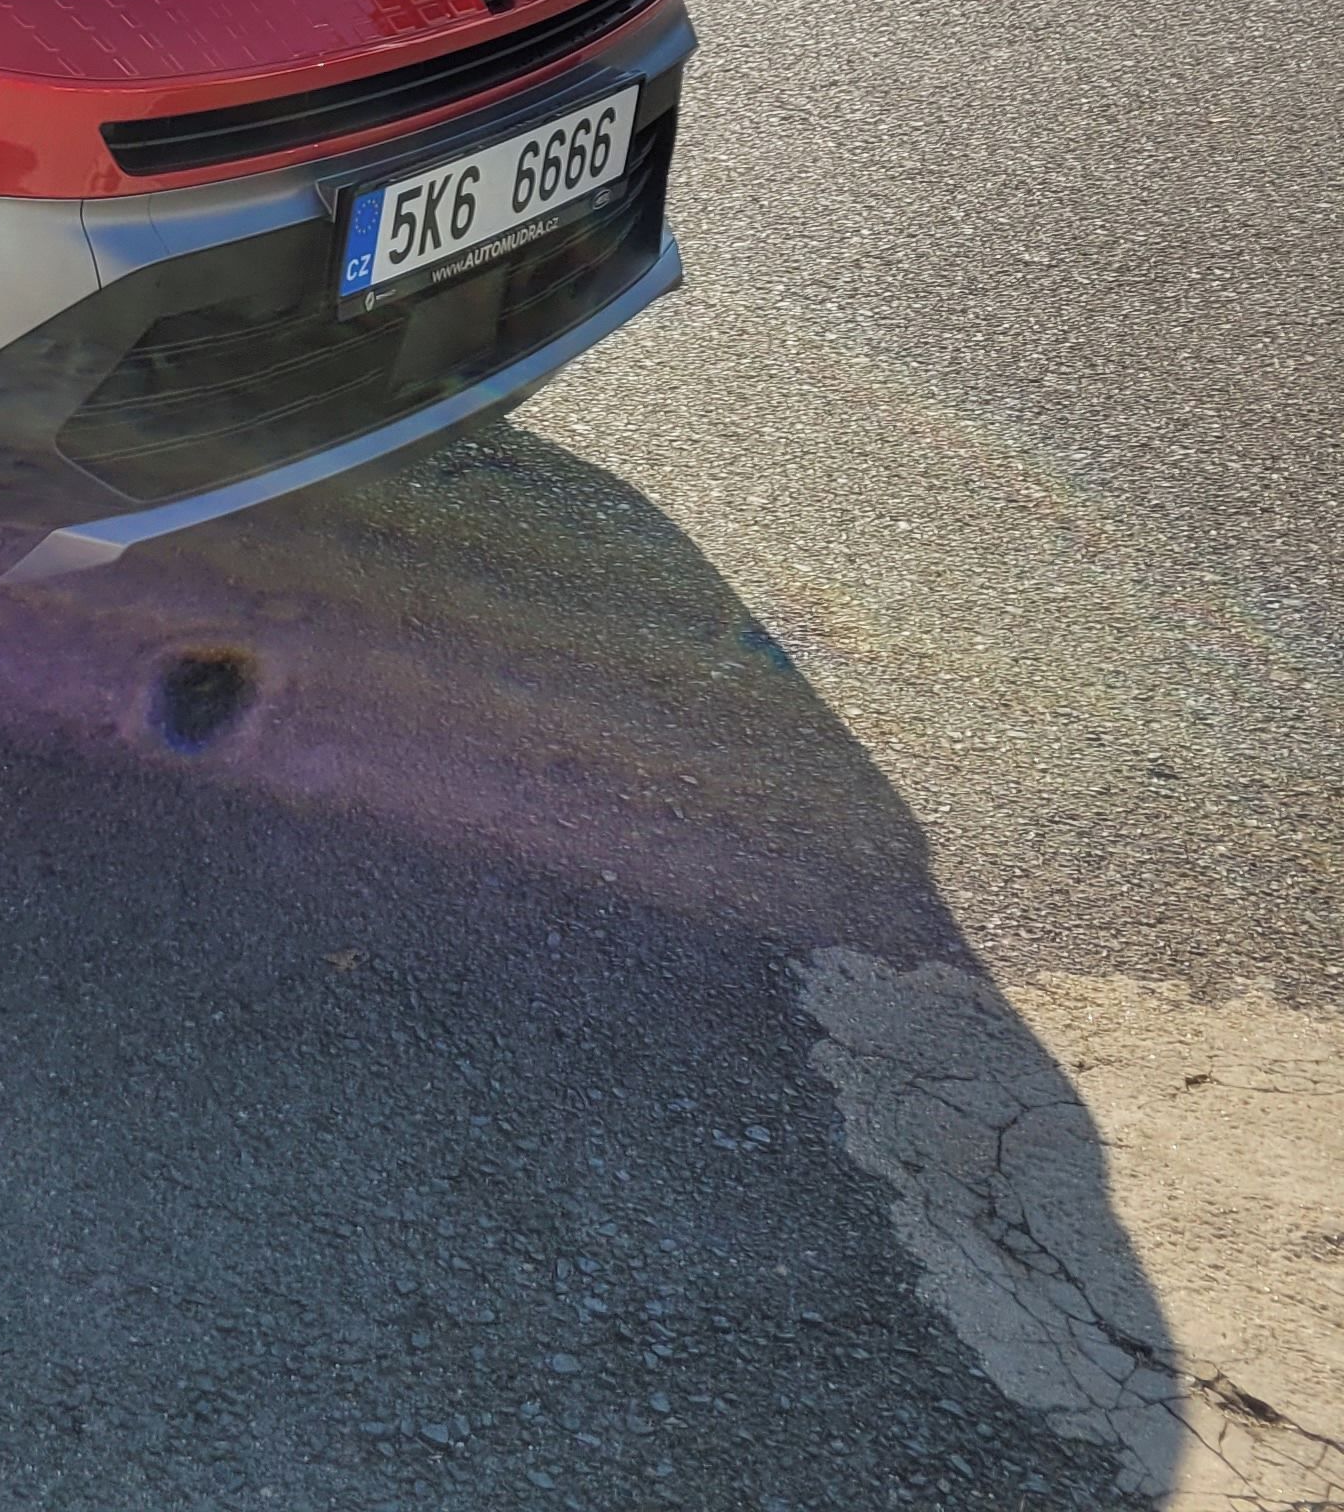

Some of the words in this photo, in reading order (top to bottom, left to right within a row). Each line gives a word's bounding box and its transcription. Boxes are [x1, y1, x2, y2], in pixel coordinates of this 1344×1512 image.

[389, 164, 481, 265] 5K6
[511, 106, 616, 214] 6666
[346, 253, 371, 281] CZ
[432, 215, 559, 283] www.AUTOMUDRA.cz
